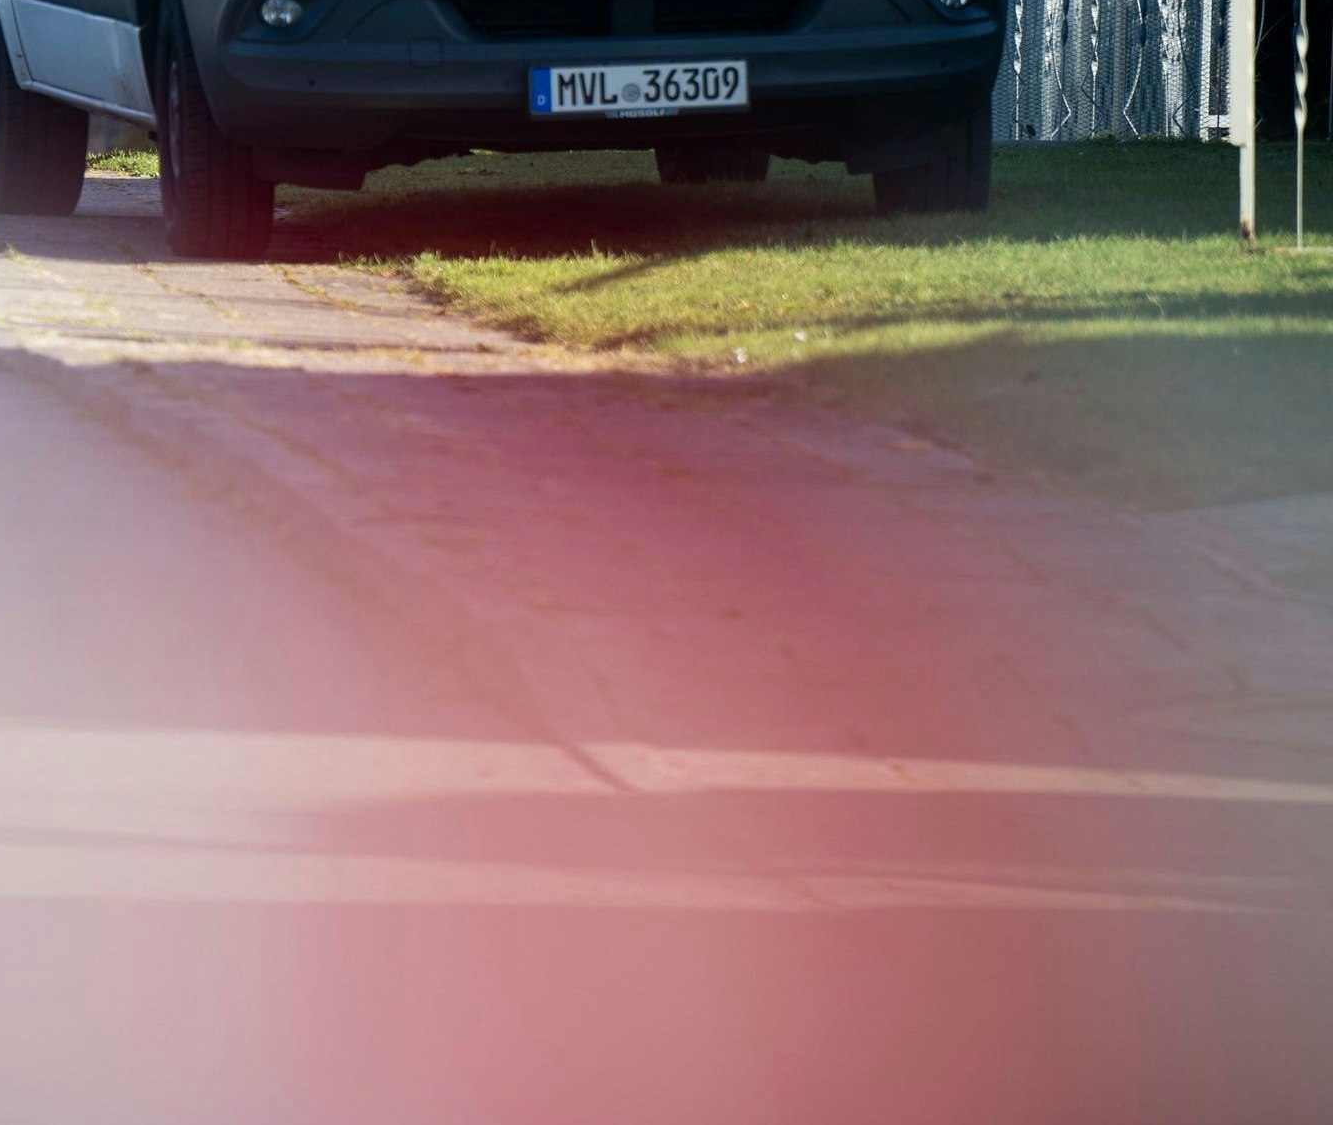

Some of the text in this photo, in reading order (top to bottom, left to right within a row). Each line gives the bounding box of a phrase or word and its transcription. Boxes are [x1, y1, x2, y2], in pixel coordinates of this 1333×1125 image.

[557, 67, 740, 106] MVL 36309
[537, 95, 546, 106] D
